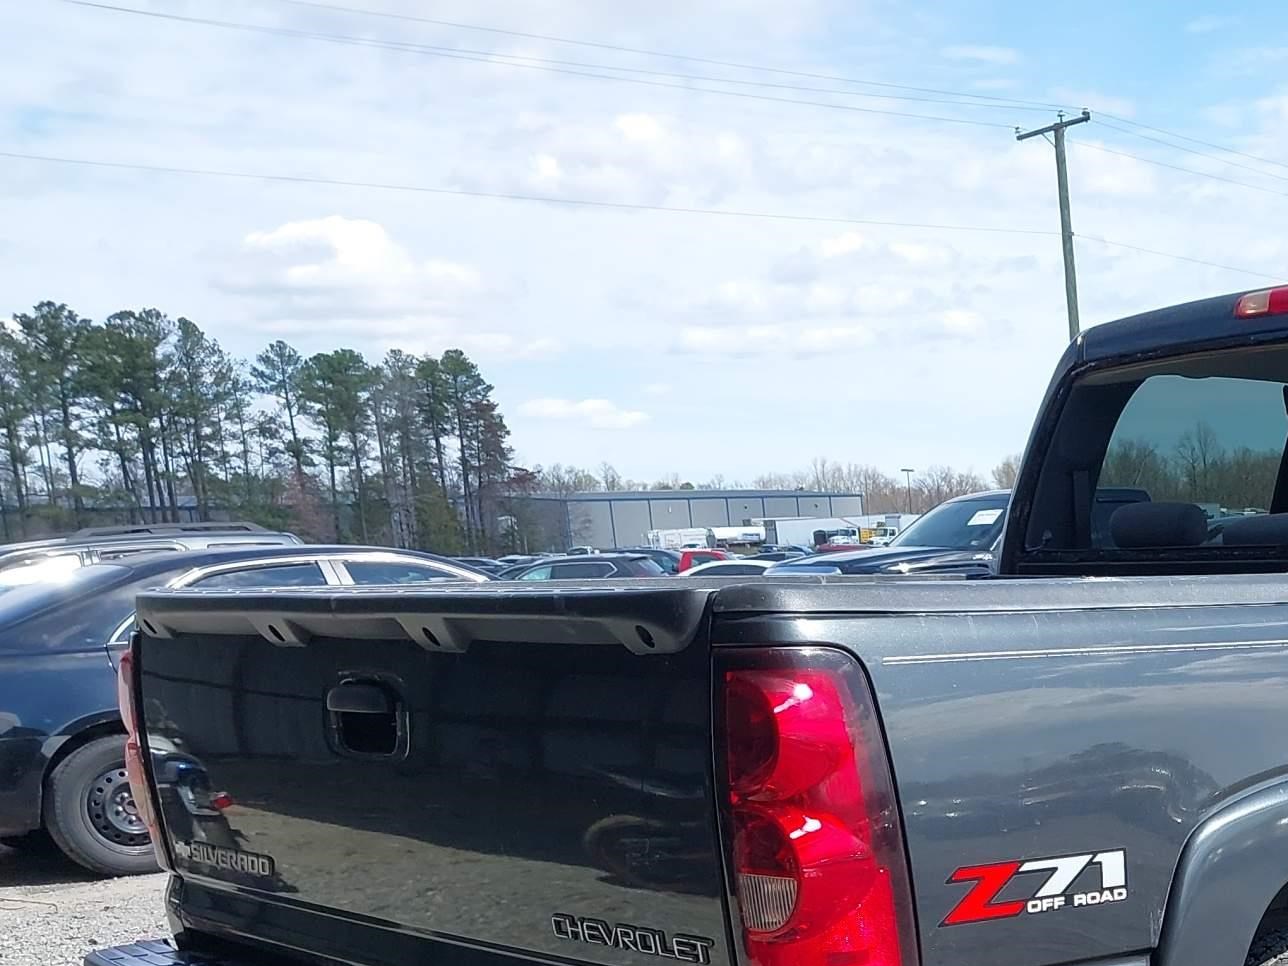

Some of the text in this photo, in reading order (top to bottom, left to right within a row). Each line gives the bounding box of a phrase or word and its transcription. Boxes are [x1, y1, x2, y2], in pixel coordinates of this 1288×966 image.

[191, 841, 272, 876] SILVERADO
[940, 848, 1126, 928] Z71
[1027, 887, 1128, 914] OFF ROAD
[551, 913, 714, 965] CHEVROLET
